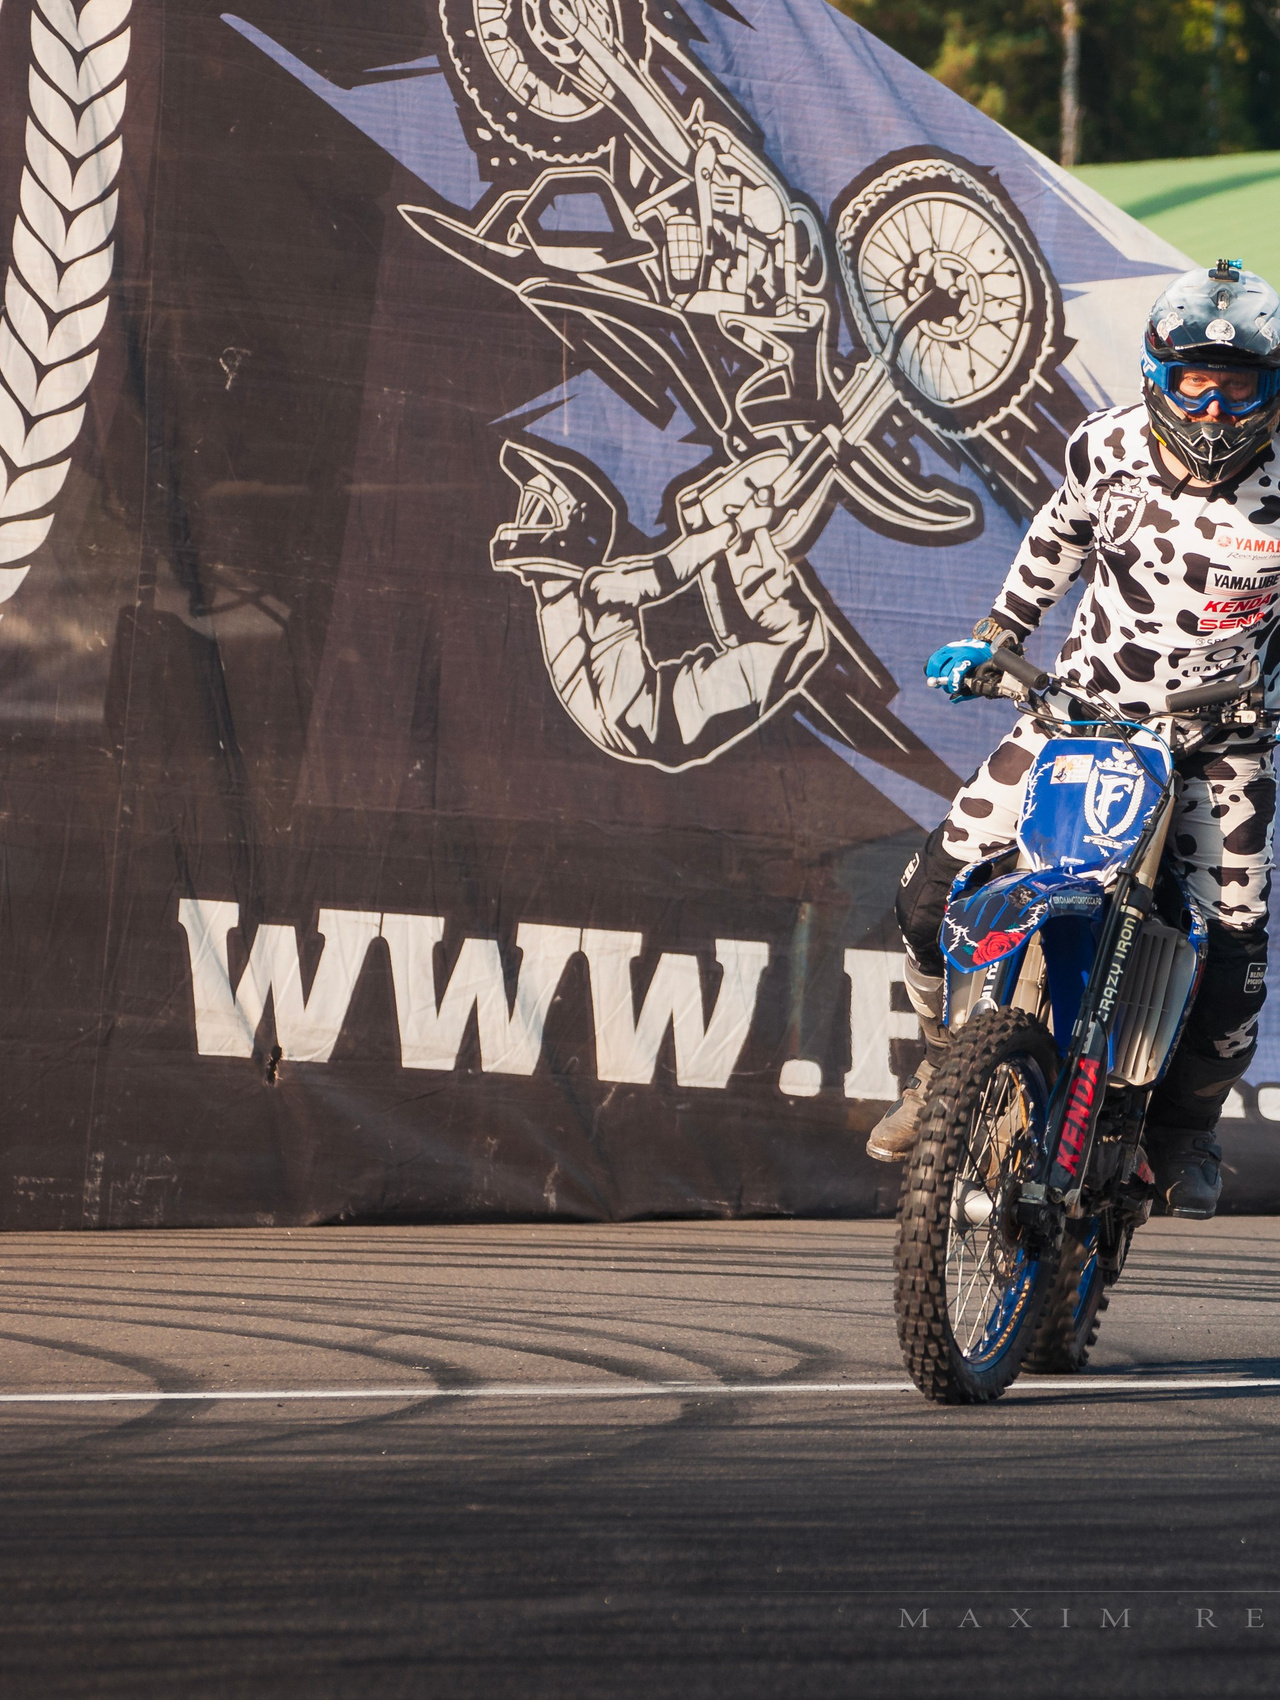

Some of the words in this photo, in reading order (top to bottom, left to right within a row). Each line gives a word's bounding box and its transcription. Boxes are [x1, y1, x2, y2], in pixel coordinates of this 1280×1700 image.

[1203, 593, 1272, 613] KENDA
[1192, 652, 1251, 673] OAKEY
[1097, 963, 1124, 1021] CRAZY
[1114, 917, 1137, 959] IRON
[1056, 1057, 1101, 1177] KENDA
